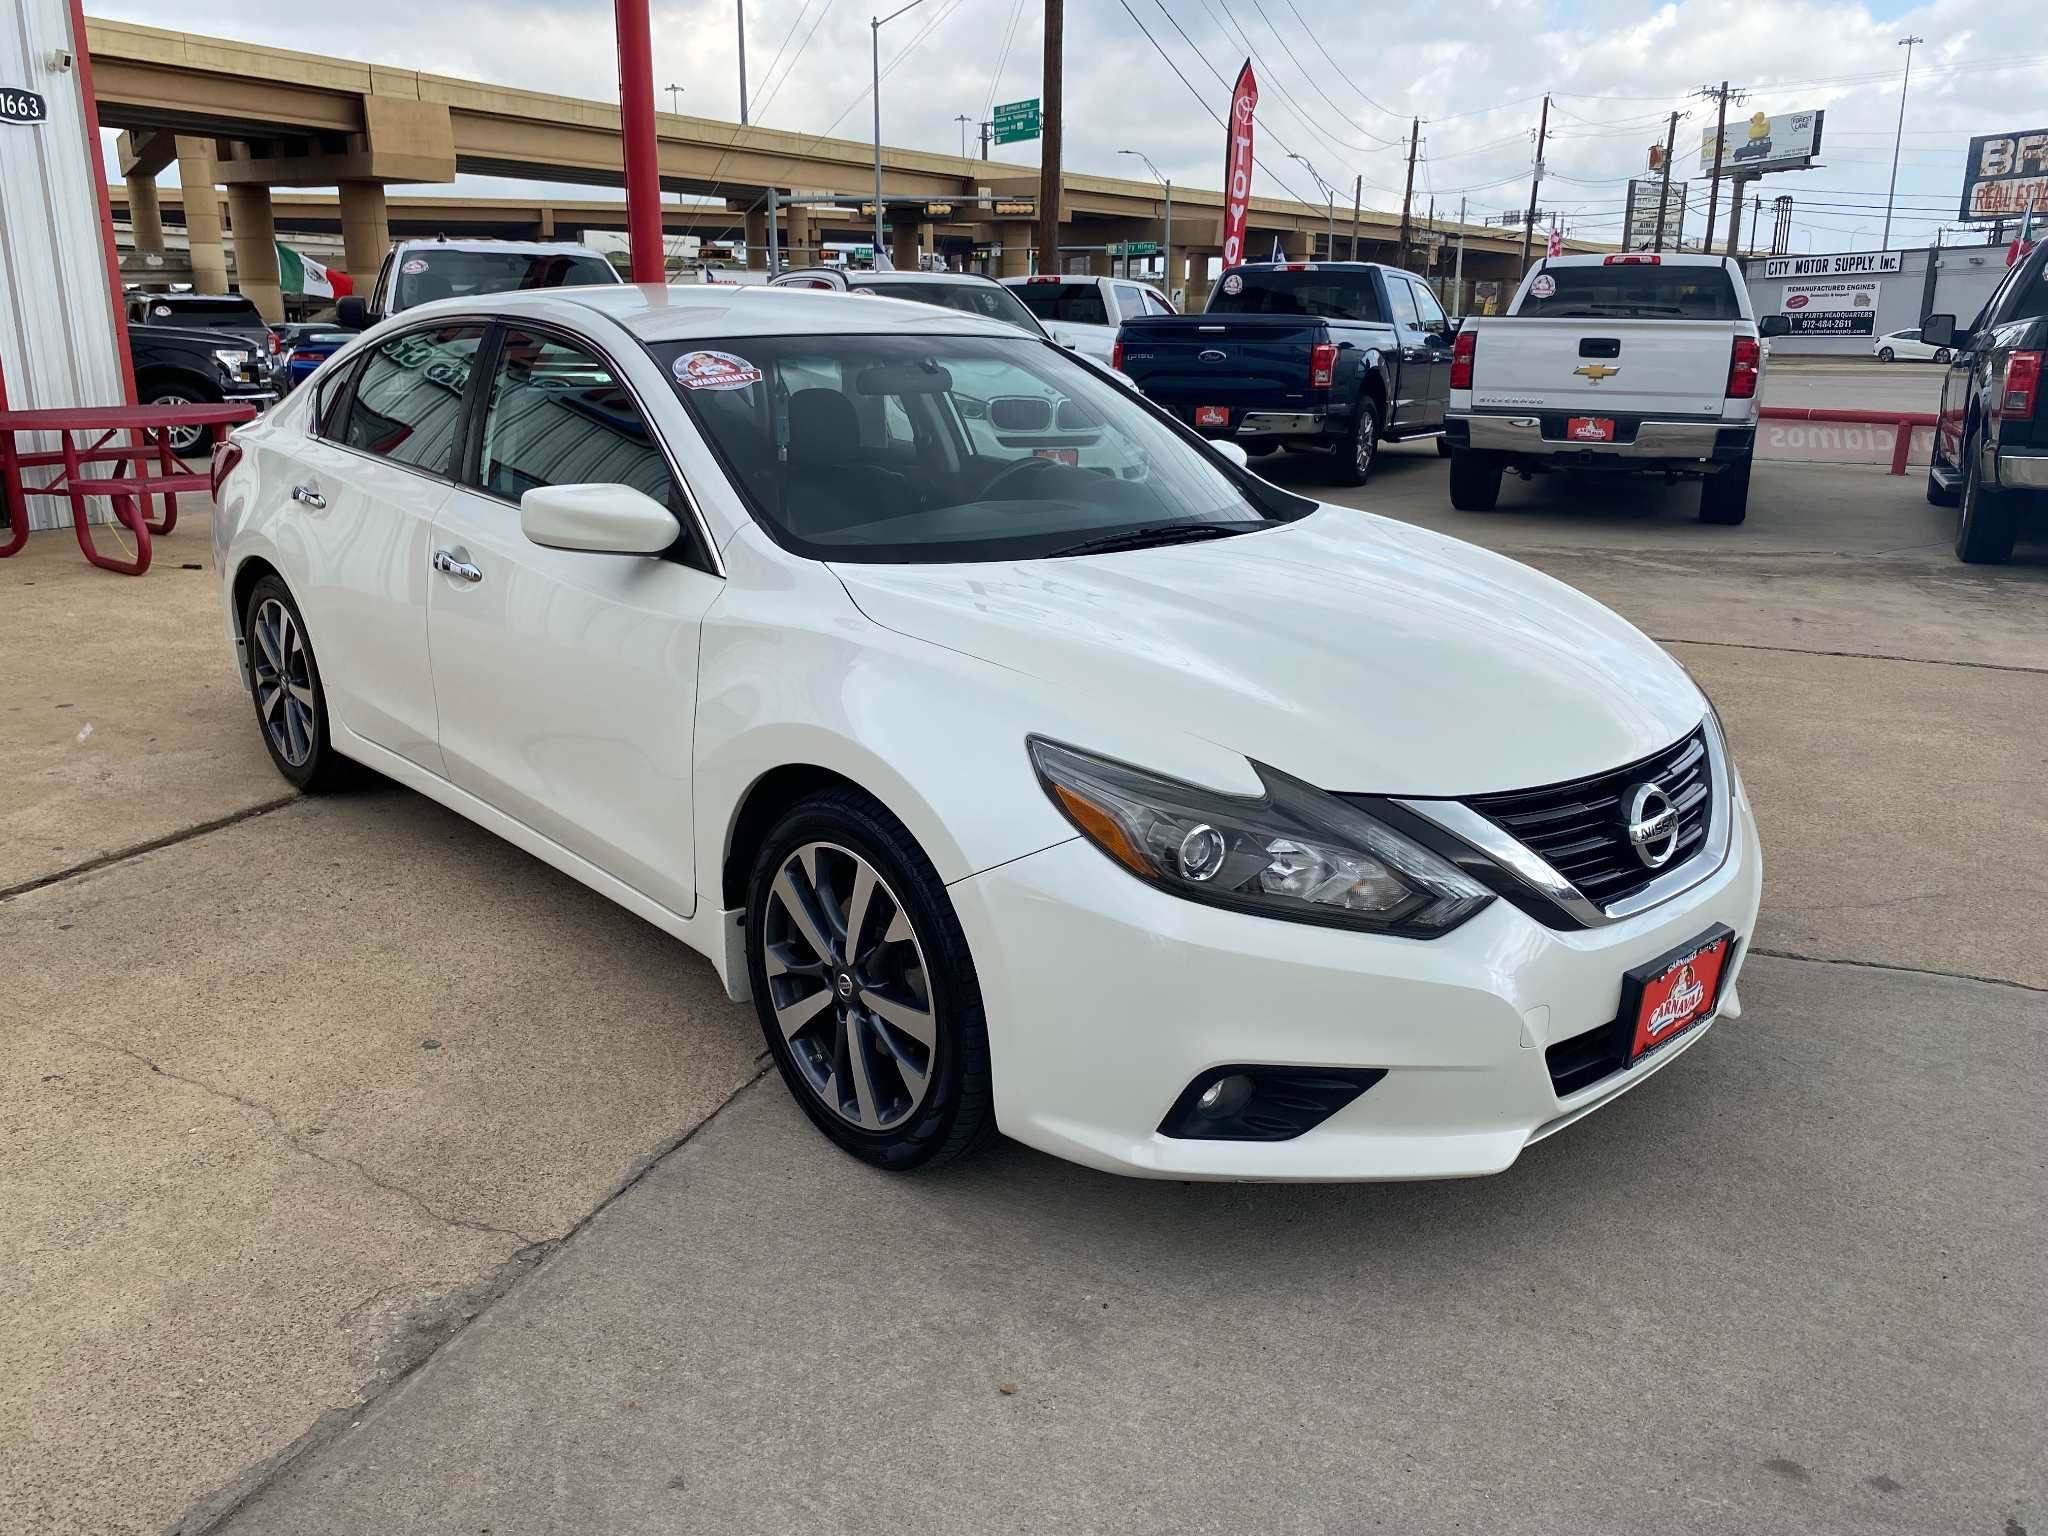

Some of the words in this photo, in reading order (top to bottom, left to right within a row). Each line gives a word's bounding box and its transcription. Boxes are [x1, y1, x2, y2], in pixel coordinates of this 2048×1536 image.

[0, 93, 39, 117] 1663
[1792, 115, 1813, 124] FOREST
[1702, 145, 1732, 159] DUS
[1974, 186, 2011, 210] REAL
[1118, 244, 1135, 252] Hry
[1137, 242, 1155, 250] Hines
[1768, 261, 1790, 275] CITY
[1795, 259, 1829, 275] MOTOR
[1787, 285, 1845, 293] REMANUFACTURED
[1824, 311, 1873, 319] HEADQUARTERS
[1802, 319, 1852, 329] 972-484-2611
[1203, 352, 1221, 361] Ford
[689, 373, 755, 388] WARRANTY
[1478, 396, 1545, 405] SILVERADO
[1648, 988, 1703, 1029] CARNAVAL
